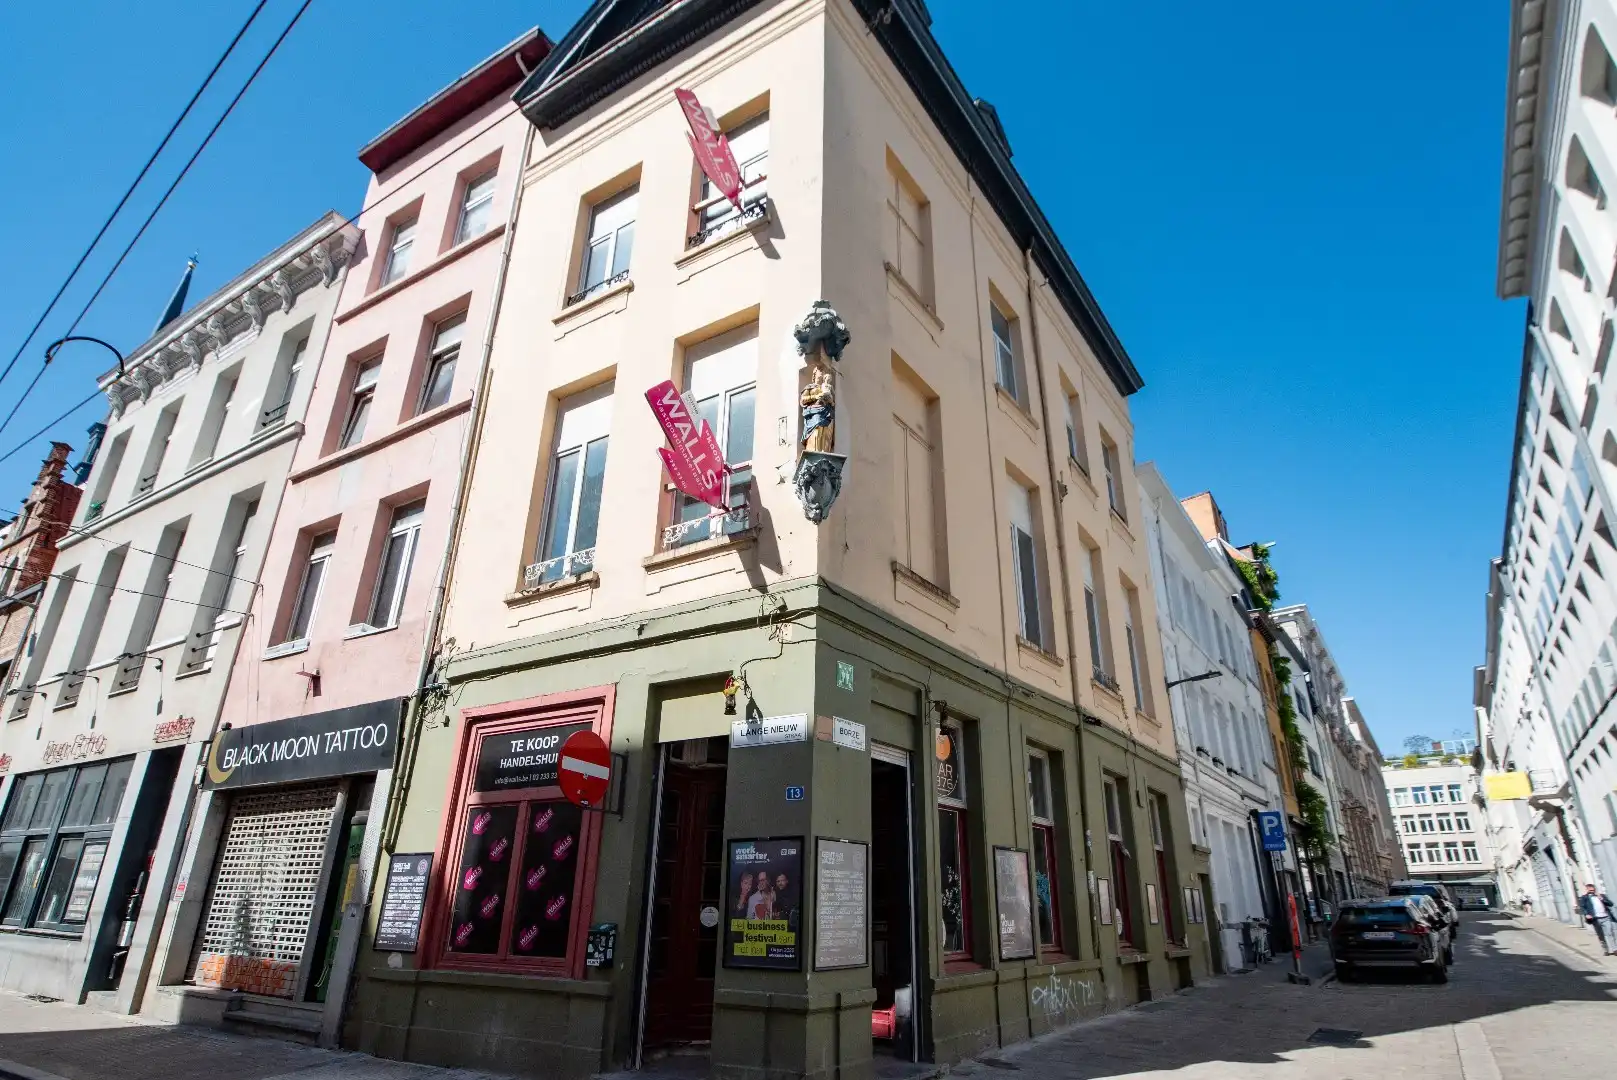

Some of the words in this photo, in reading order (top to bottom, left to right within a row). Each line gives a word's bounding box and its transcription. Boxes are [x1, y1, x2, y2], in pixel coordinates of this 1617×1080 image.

[687, 99, 735, 188] WALLS
[662, 388, 718, 490] WALLS
[706, 435, 721, 463] koop
[740, 726, 768, 737] LANGE
[770, 723, 798, 734] NIEUW
[839, 727, 860, 740] BORZE
[223, 742, 270, 769] BLACK
[271, 734, 320, 762] MOON
[324, 723, 388, 753] TATTOO
[510, 740, 524, 753] TE
[526, 735, 559, 751] KOOP
[500, 753, 558, 769] HANDELSHUI
[937, 762, 953, 778] AR
[790, 788, 801, 798] 13
[474, 811, 492, 831] WALLS
[535, 808, 554, 829] WALLS
[1262, 815, 1279, 836] P
[491, 836, 508, 858] WALLS
[554, 835, 572, 857] WALLS
[735, 845, 756, 855] work
[735, 851, 768, 861] smarter
[465, 866, 483, 886] WALLS
[527, 864, 546, 886] WALLS
[482, 894, 499, 915] WALLS
[546, 895, 565, 916] WALLS
[456, 921, 474, 942] WALLS
[520, 925, 538, 946] WALLS
[746, 921, 786, 931] business
[744, 933, 777, 943] festival
